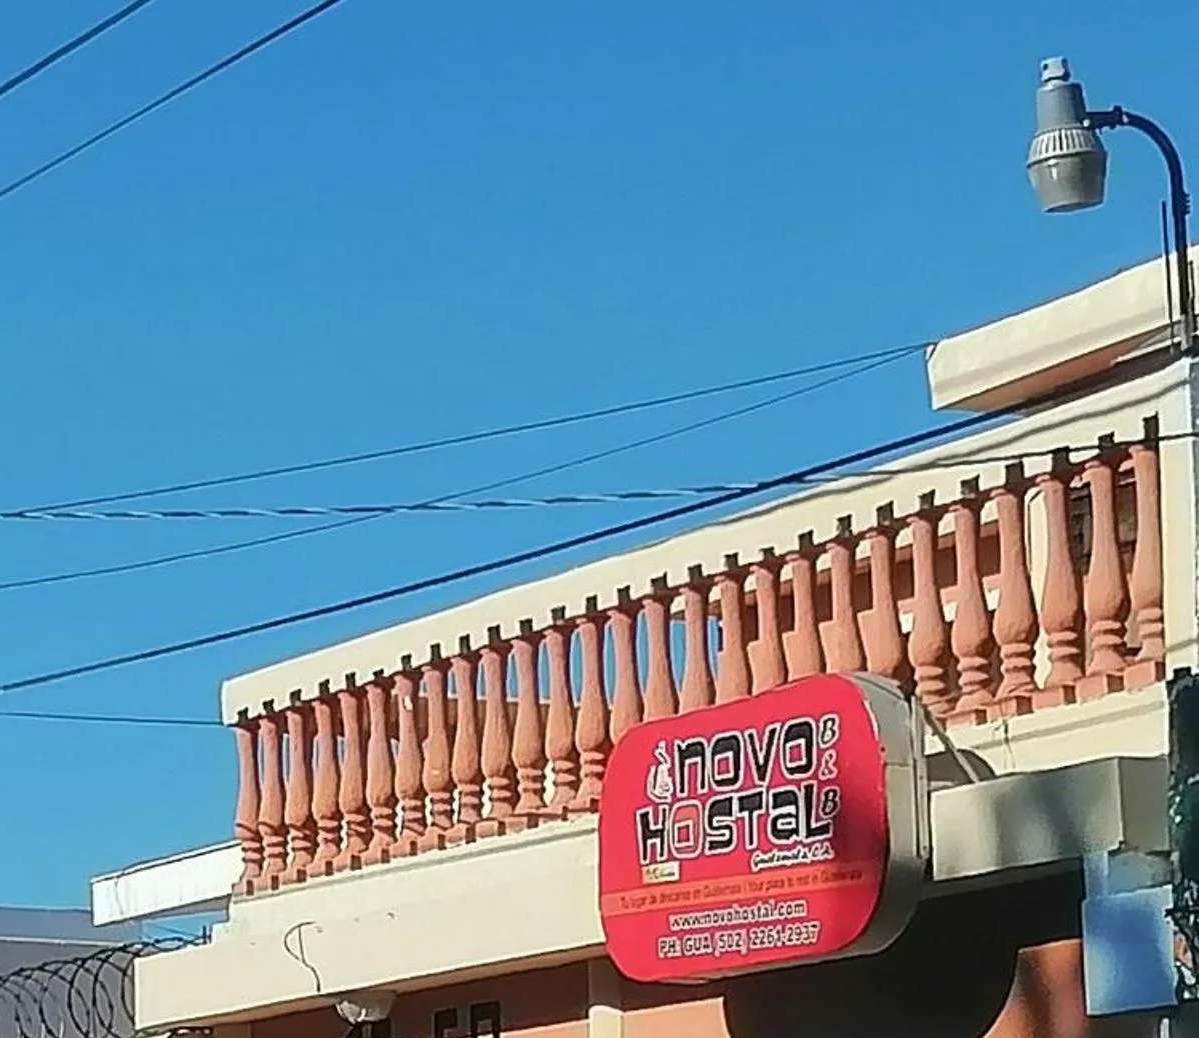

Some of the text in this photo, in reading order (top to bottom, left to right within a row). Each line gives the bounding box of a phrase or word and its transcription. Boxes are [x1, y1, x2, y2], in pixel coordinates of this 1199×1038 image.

[820, 715, 838, 746] B
[821, 788, 838, 816] B
[683, 933, 712, 954] GUA
